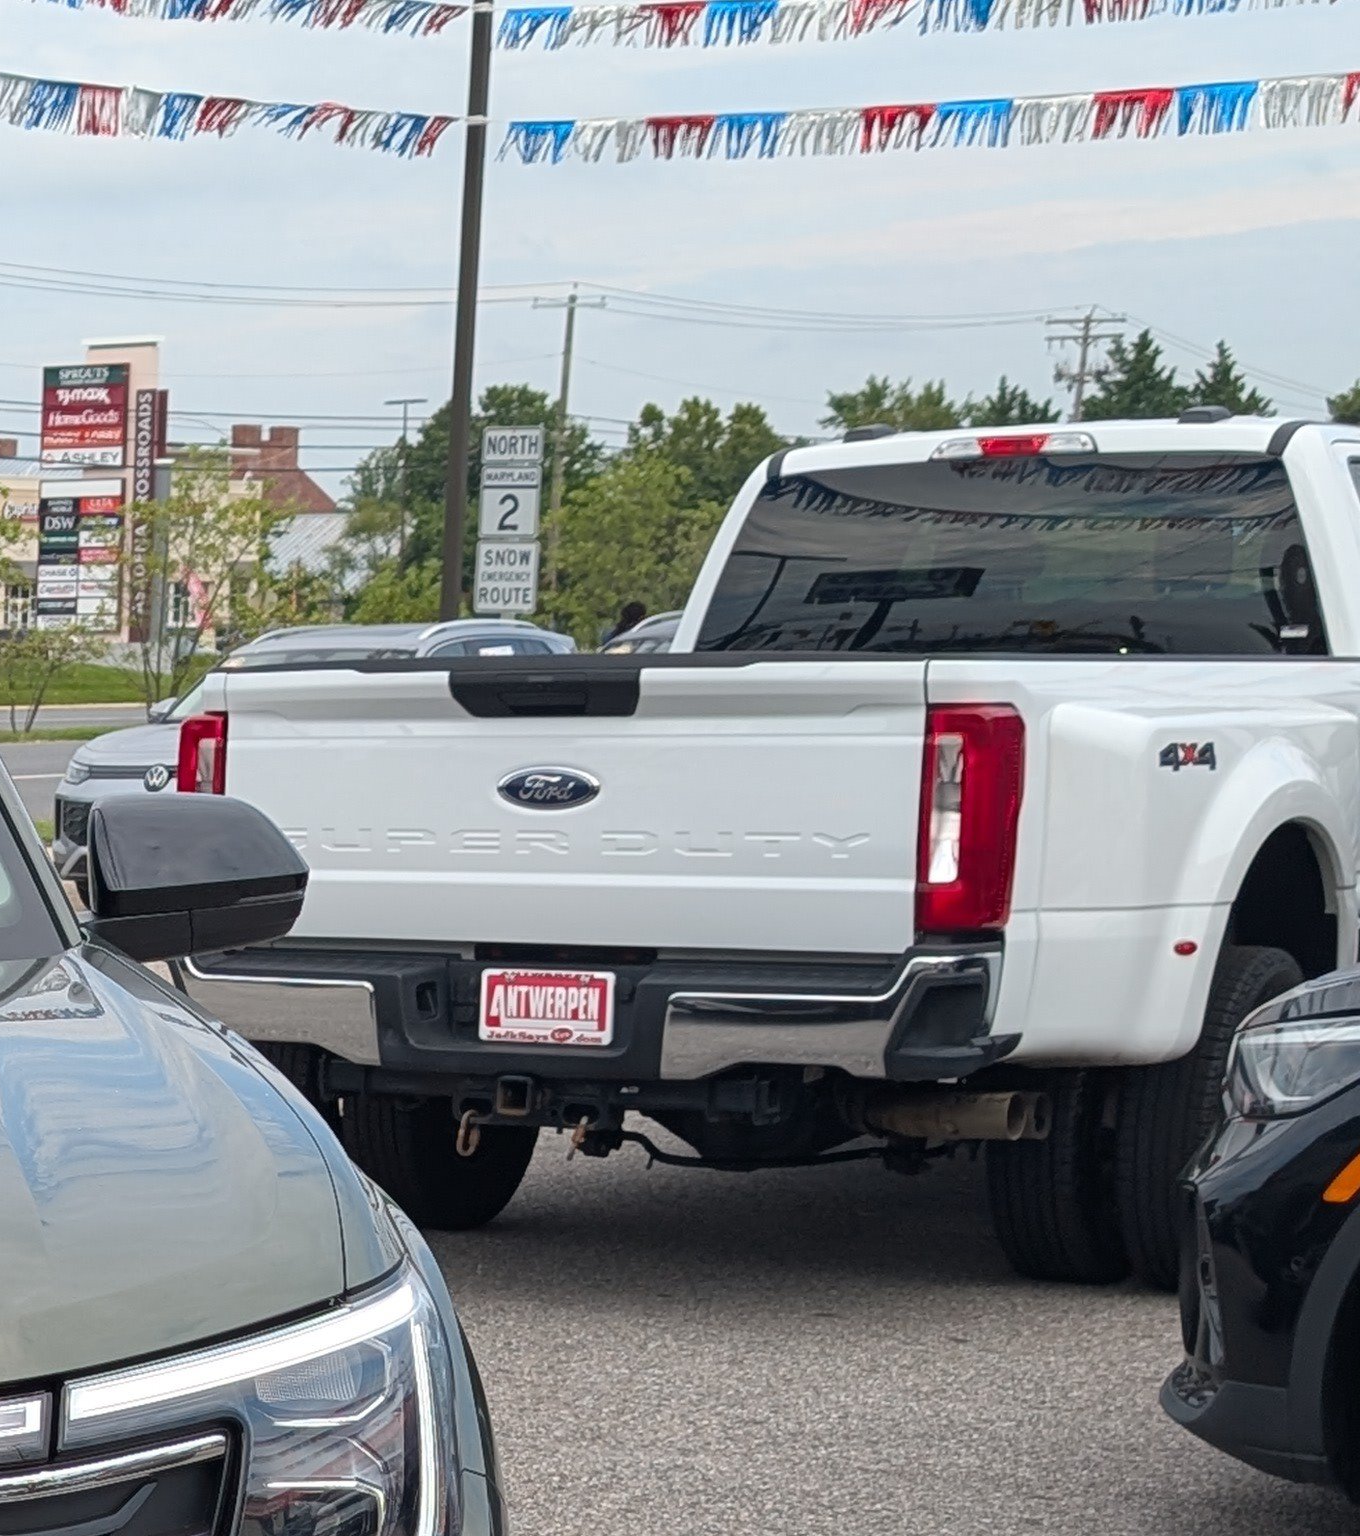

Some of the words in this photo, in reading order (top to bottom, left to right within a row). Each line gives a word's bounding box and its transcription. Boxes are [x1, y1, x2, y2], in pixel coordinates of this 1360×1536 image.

[59, 367, 109, 380] SPROUTS
[48, 409, 120, 427] HomeGoods
[135, 391, 153, 506] ROSSROADS
[486, 435, 538, 455] NORTH
[61, 451, 119, 464] ASHLEY
[486, 471, 536, 481] MARYLAND
[497, 494, 519, 531] 2
[44, 516, 75, 530] DSW
[483, 550, 531, 566] SNOW
[481, 571, 530, 582] EMERGENCY
[479, 587, 531, 605] ROUTE
[518, 774, 574, 800] Ford
[601, 830, 871, 859] DUTY
[489, 984, 600, 1021] ANTWERPEN
